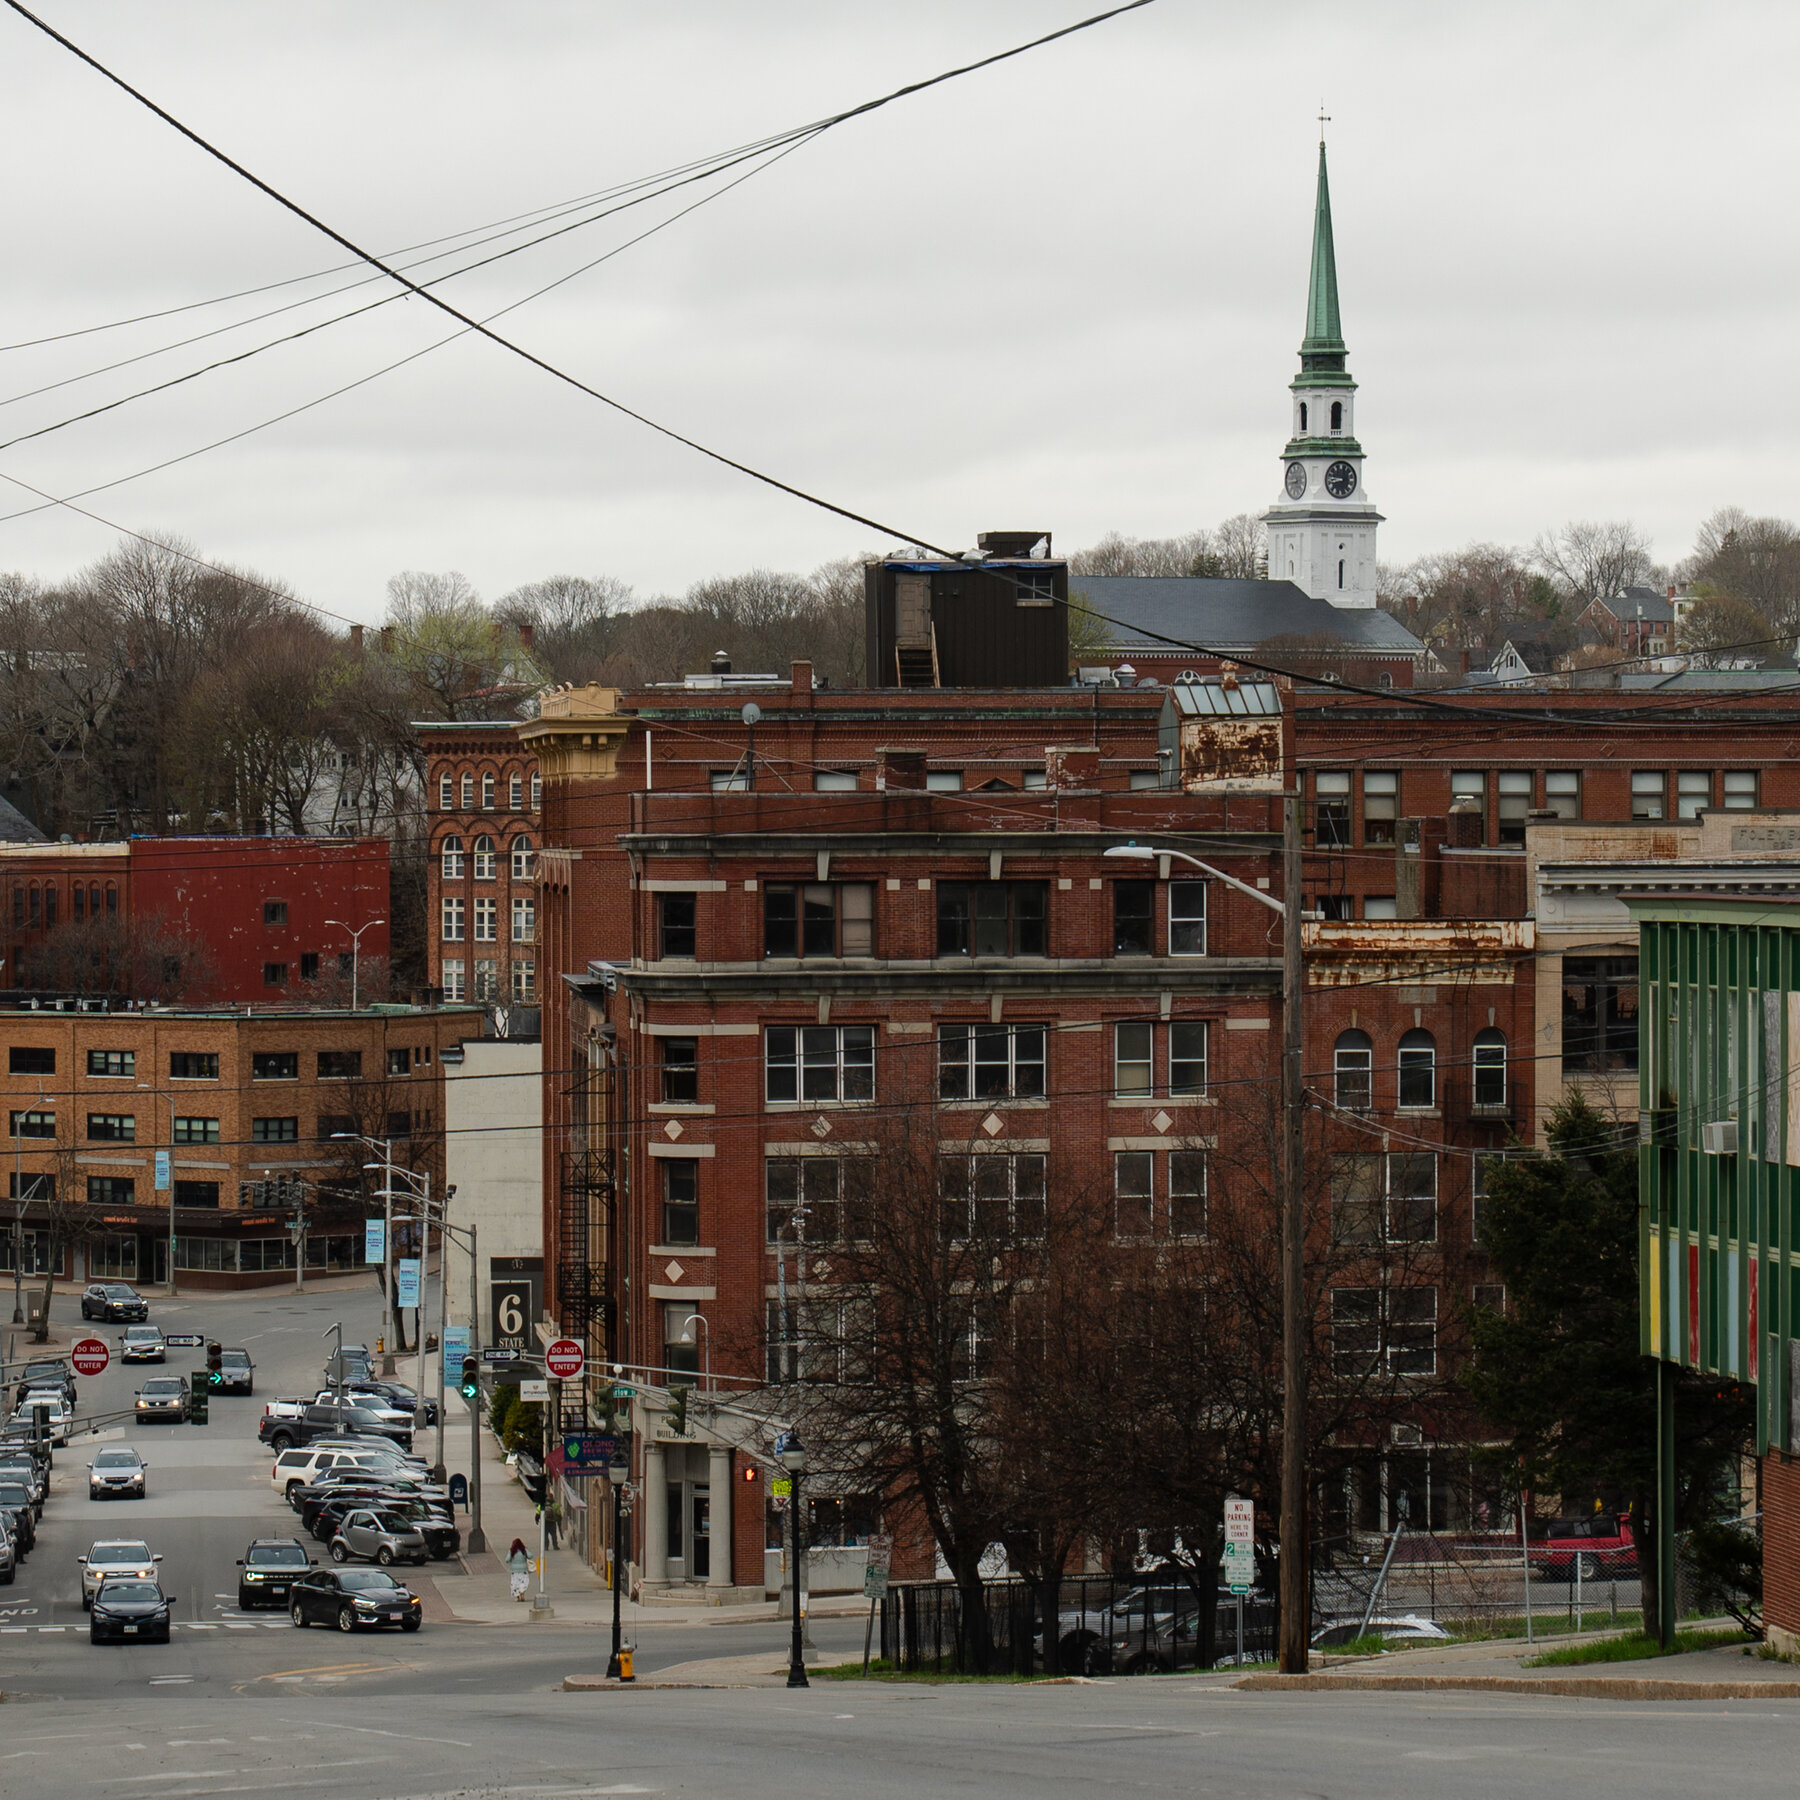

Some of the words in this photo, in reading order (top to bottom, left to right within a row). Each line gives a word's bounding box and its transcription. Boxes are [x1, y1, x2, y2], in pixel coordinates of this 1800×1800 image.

[1740, 829, 1785, 841] FOLEY
[1788, 829, 1800, 841] B
[499, 1294, 523, 1335] 6
[499, 1337, 525, 1348] STATE
[553, 1363, 577, 1371] ENTER
[1234, 1503, 1244, 1511] NO
[1227, 1513, 1252, 1521] PARKING
[1227, 1543, 1234, 1556] 2
[867, 1567, 873, 1577] 2
